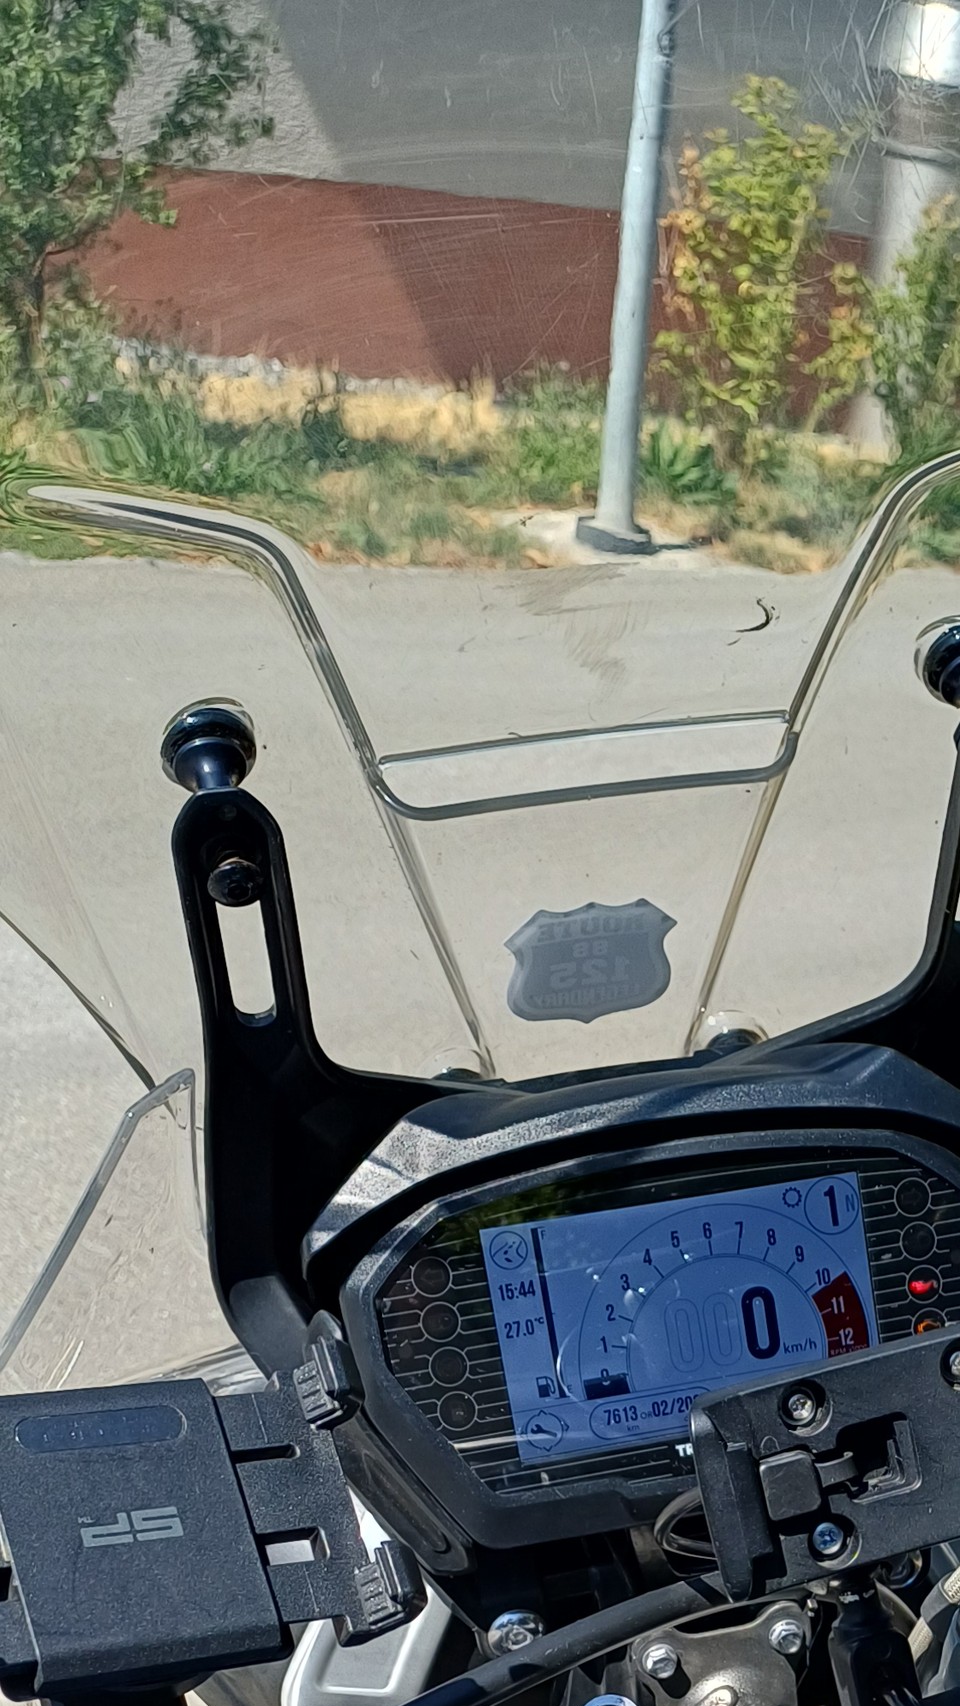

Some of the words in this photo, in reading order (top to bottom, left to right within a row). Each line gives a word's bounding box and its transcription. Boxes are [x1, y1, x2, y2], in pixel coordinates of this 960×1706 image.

[823, 1185, 839, 1227] 1
[703, 1222, 712, 1239] 6
[735, 1221, 743, 1238] 7
[767, 1228, 777, 1246] 8
[671, 1230, 680, 1248] 5
[643, 1248, 653, 1266] 4
[795, 1245, 804, 1262] 9
[620, 1273, 630, 1291] 3
[815, 1267, 831, 1286] 10
[498, 1279, 536, 1301] 15:44
[606, 1304, 616, 1322] 2
[831, 1296, 845, 1314] 11
[600, 1336, 608, 1353] 1
[783, 1337, 817, 1354] km/h
[839, 1327, 854, 1346] 12
[604, 1405, 638, 1426] 7613
[652, 1394, 699, 1418] 02/20
[80, 1506, 184, 1548] SP
